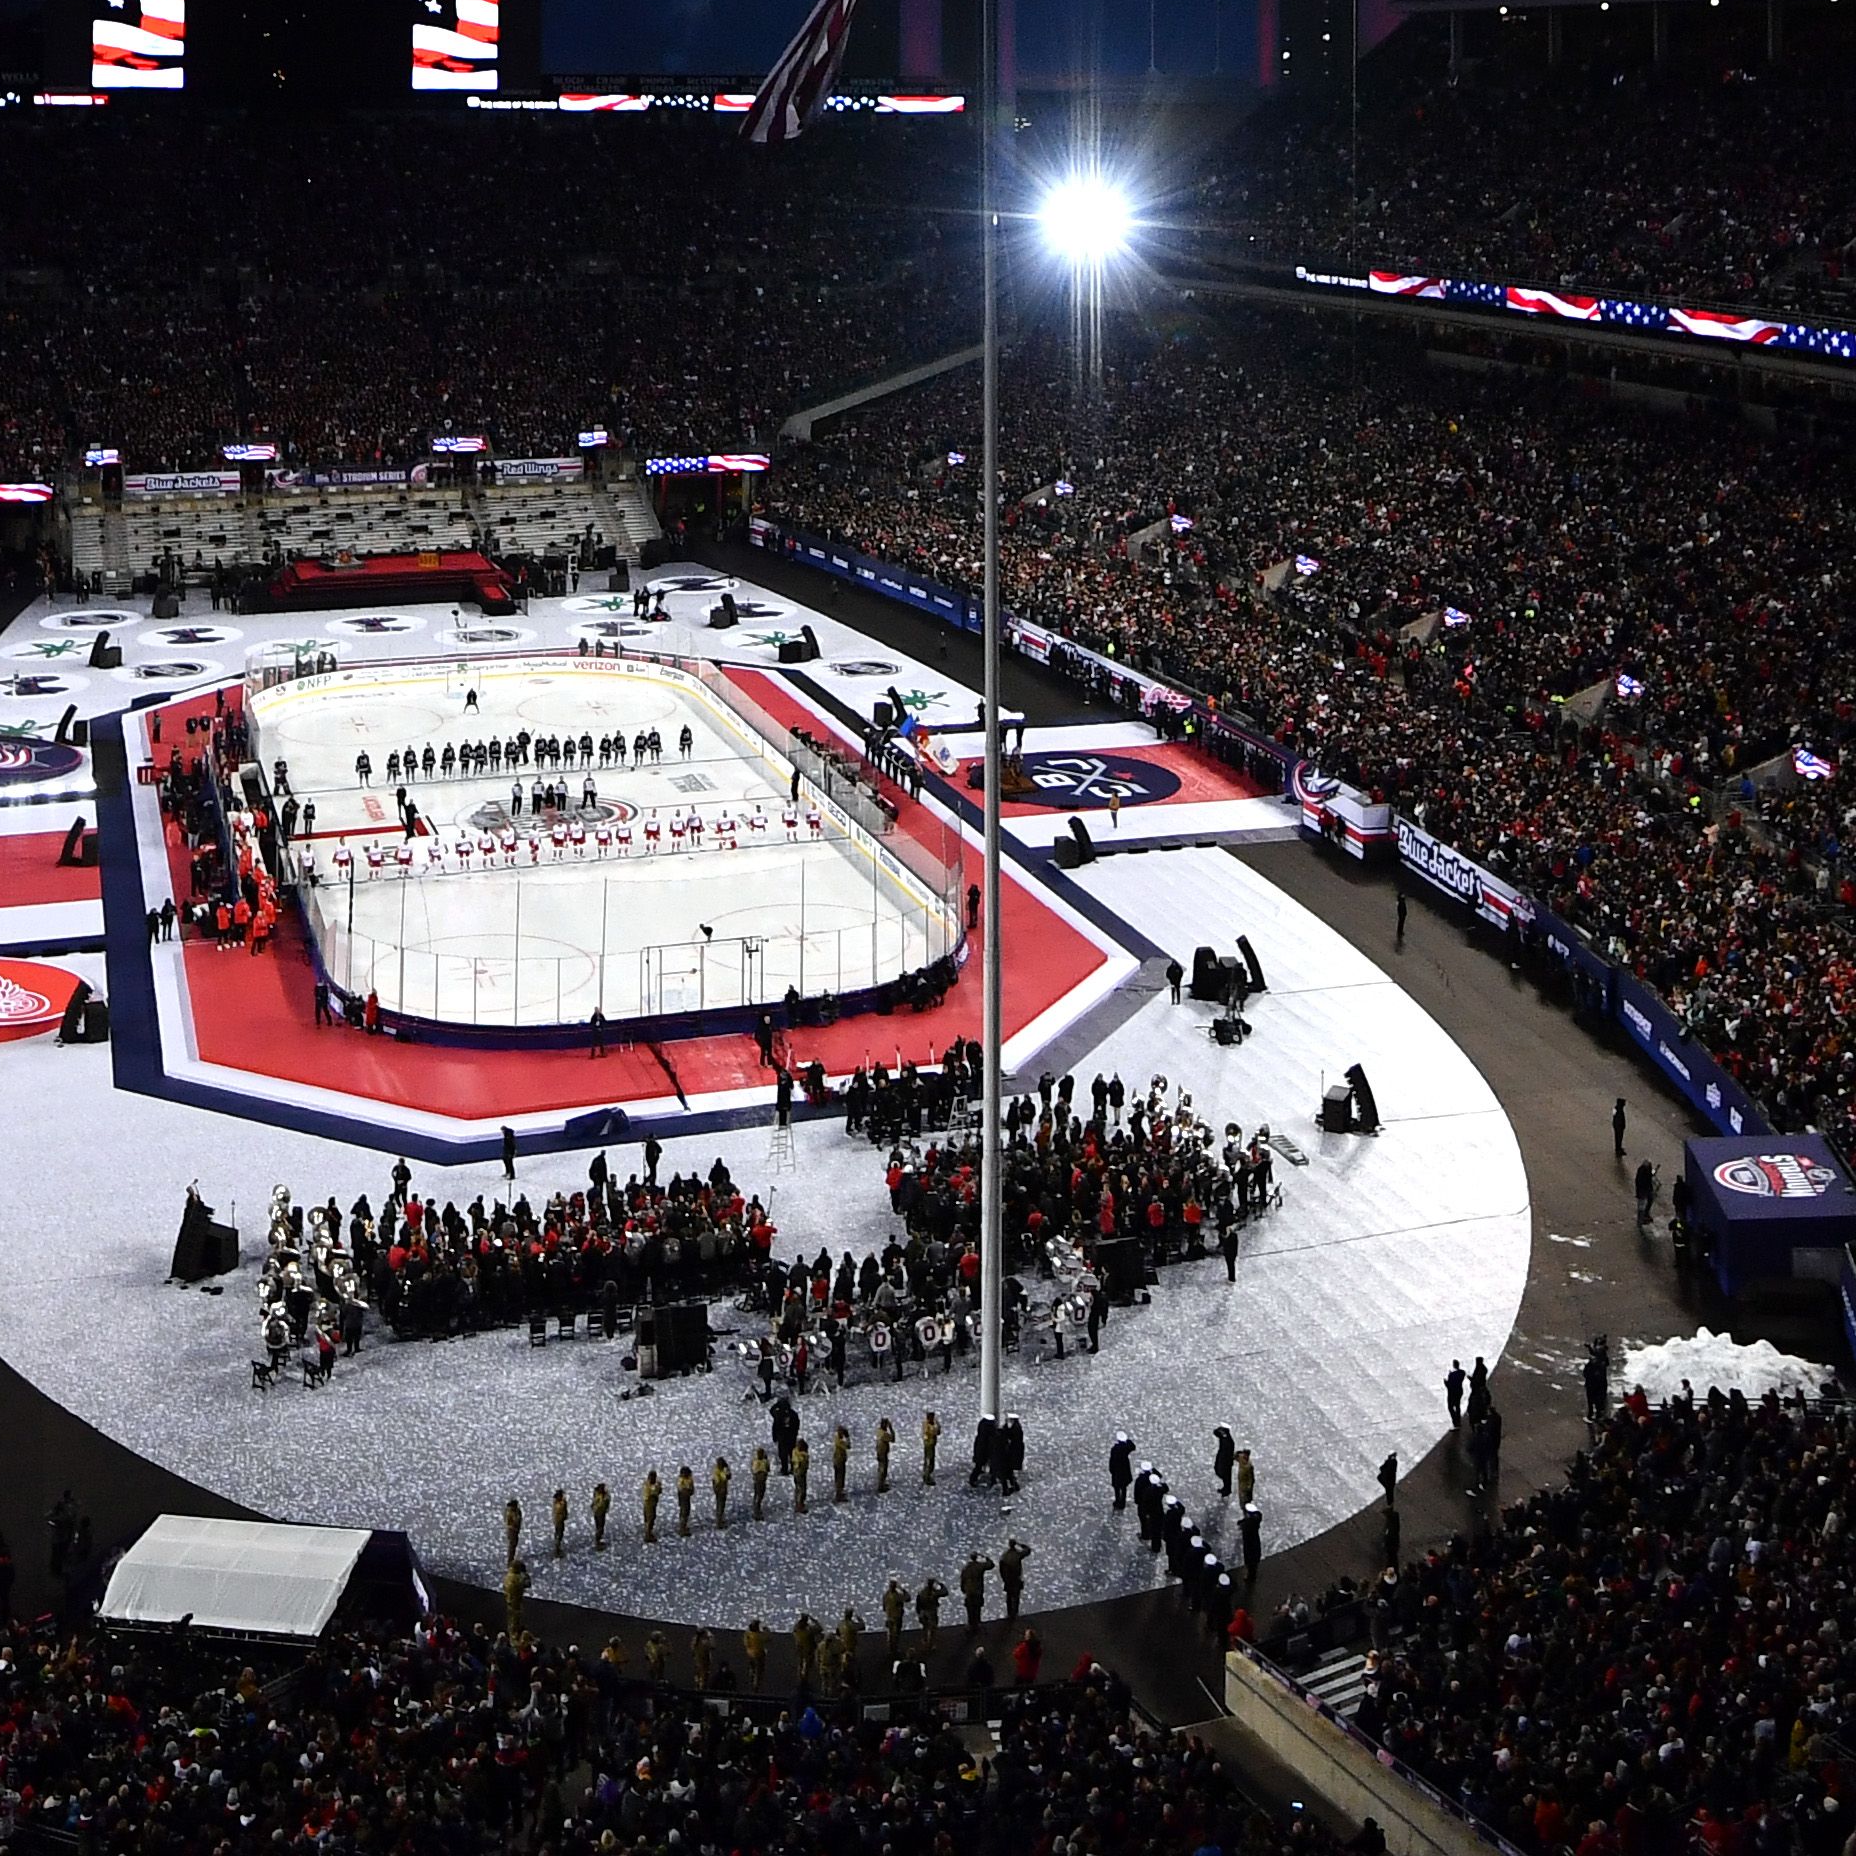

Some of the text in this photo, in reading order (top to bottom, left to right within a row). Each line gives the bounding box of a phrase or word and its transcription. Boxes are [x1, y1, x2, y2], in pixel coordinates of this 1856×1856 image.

[342, 472, 378, 483] STADIUM
[378, 471, 406, 482] SERIES
[503, 464, 558, 477] Red Wings
[146, 476, 221, 490] Blue Jackets
[573, 661, 621, 672] verizon
[307, 675, 332, 689] NFP
[1398, 823, 1484, 905] Blue Jackets
[1760, 1154, 1818, 1198] STADIUM
